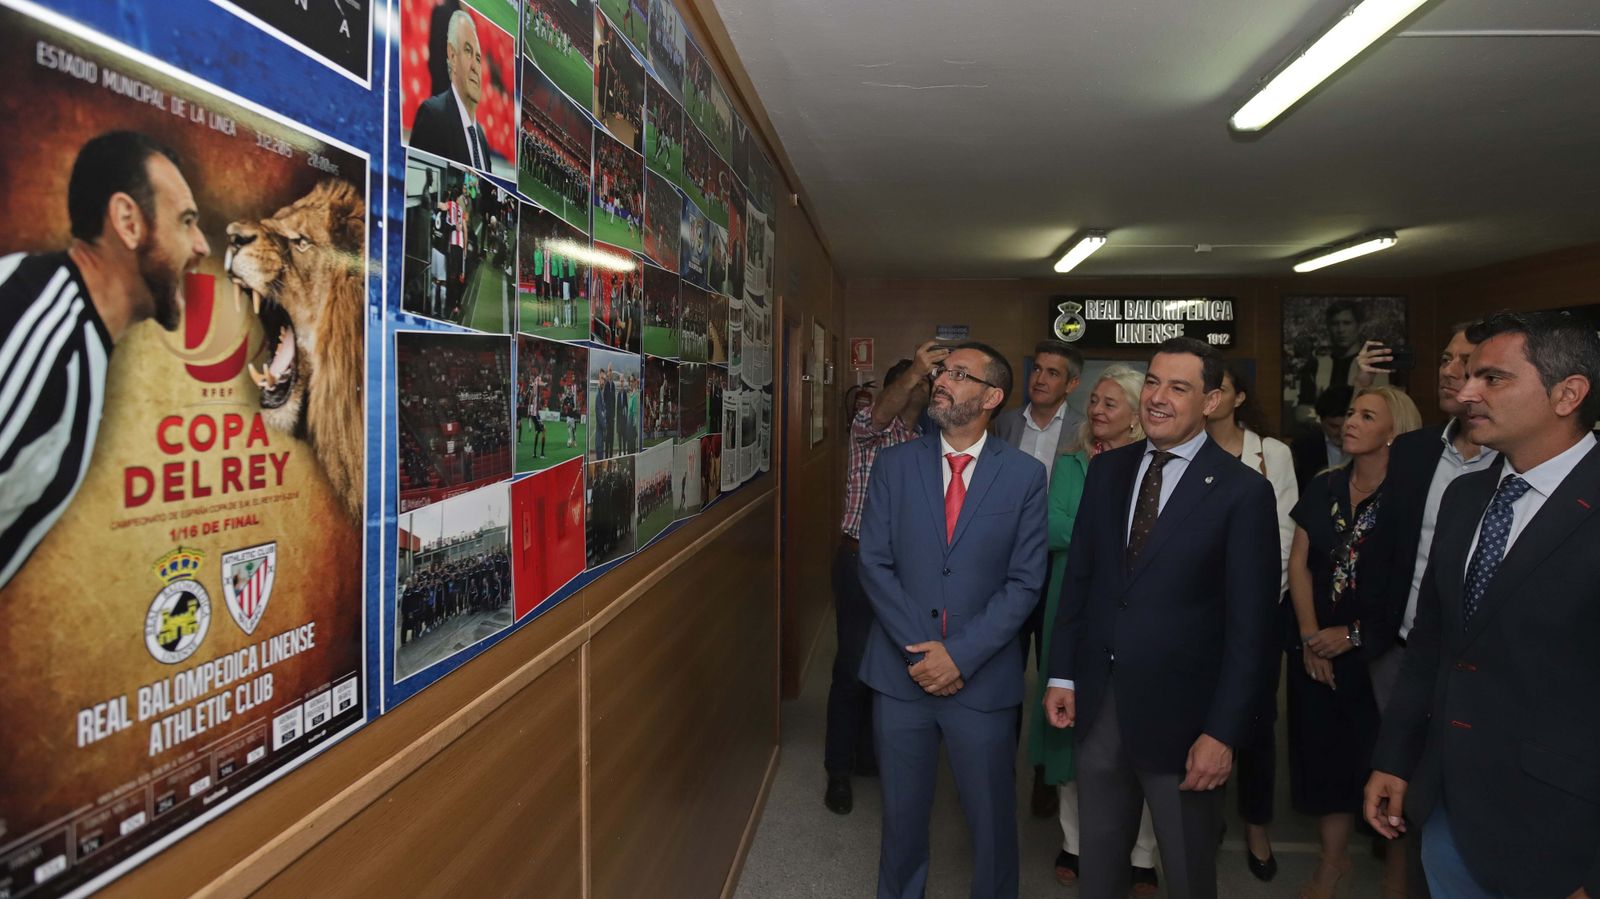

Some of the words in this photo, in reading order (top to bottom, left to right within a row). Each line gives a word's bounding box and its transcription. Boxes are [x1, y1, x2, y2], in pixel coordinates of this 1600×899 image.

[36, 41, 98, 84] ESTADIO
[102, 69, 166, 111] MUNICIPAL
[170, 96, 186, 118] DE
[190, 103, 206, 125] LA
[1085, 299, 1123, 320] REAL
[1116, 323, 1185, 344] LINENSE
[1207, 333, 1231, 345] 1912
[202, 388, 234, 398] RFEF
[156, 412, 270, 455] COPA
[124, 460, 212, 509] DEL
[222, 451, 290, 494] REY
[169, 525, 198, 542] 1/16
[202, 521, 220, 535] DE
[223, 513, 260, 531] FINAL
[224, 550, 256, 565] ATHLETIC
[257, 545, 274, 556] CLUB
[77, 695, 133, 748] REAL
[137, 644, 259, 722] BALOMPEDICA
[260, 621, 316, 668] LINENSE
[149, 692, 233, 757] ATHLETIC
[235, 672, 274, 715] CLUB
